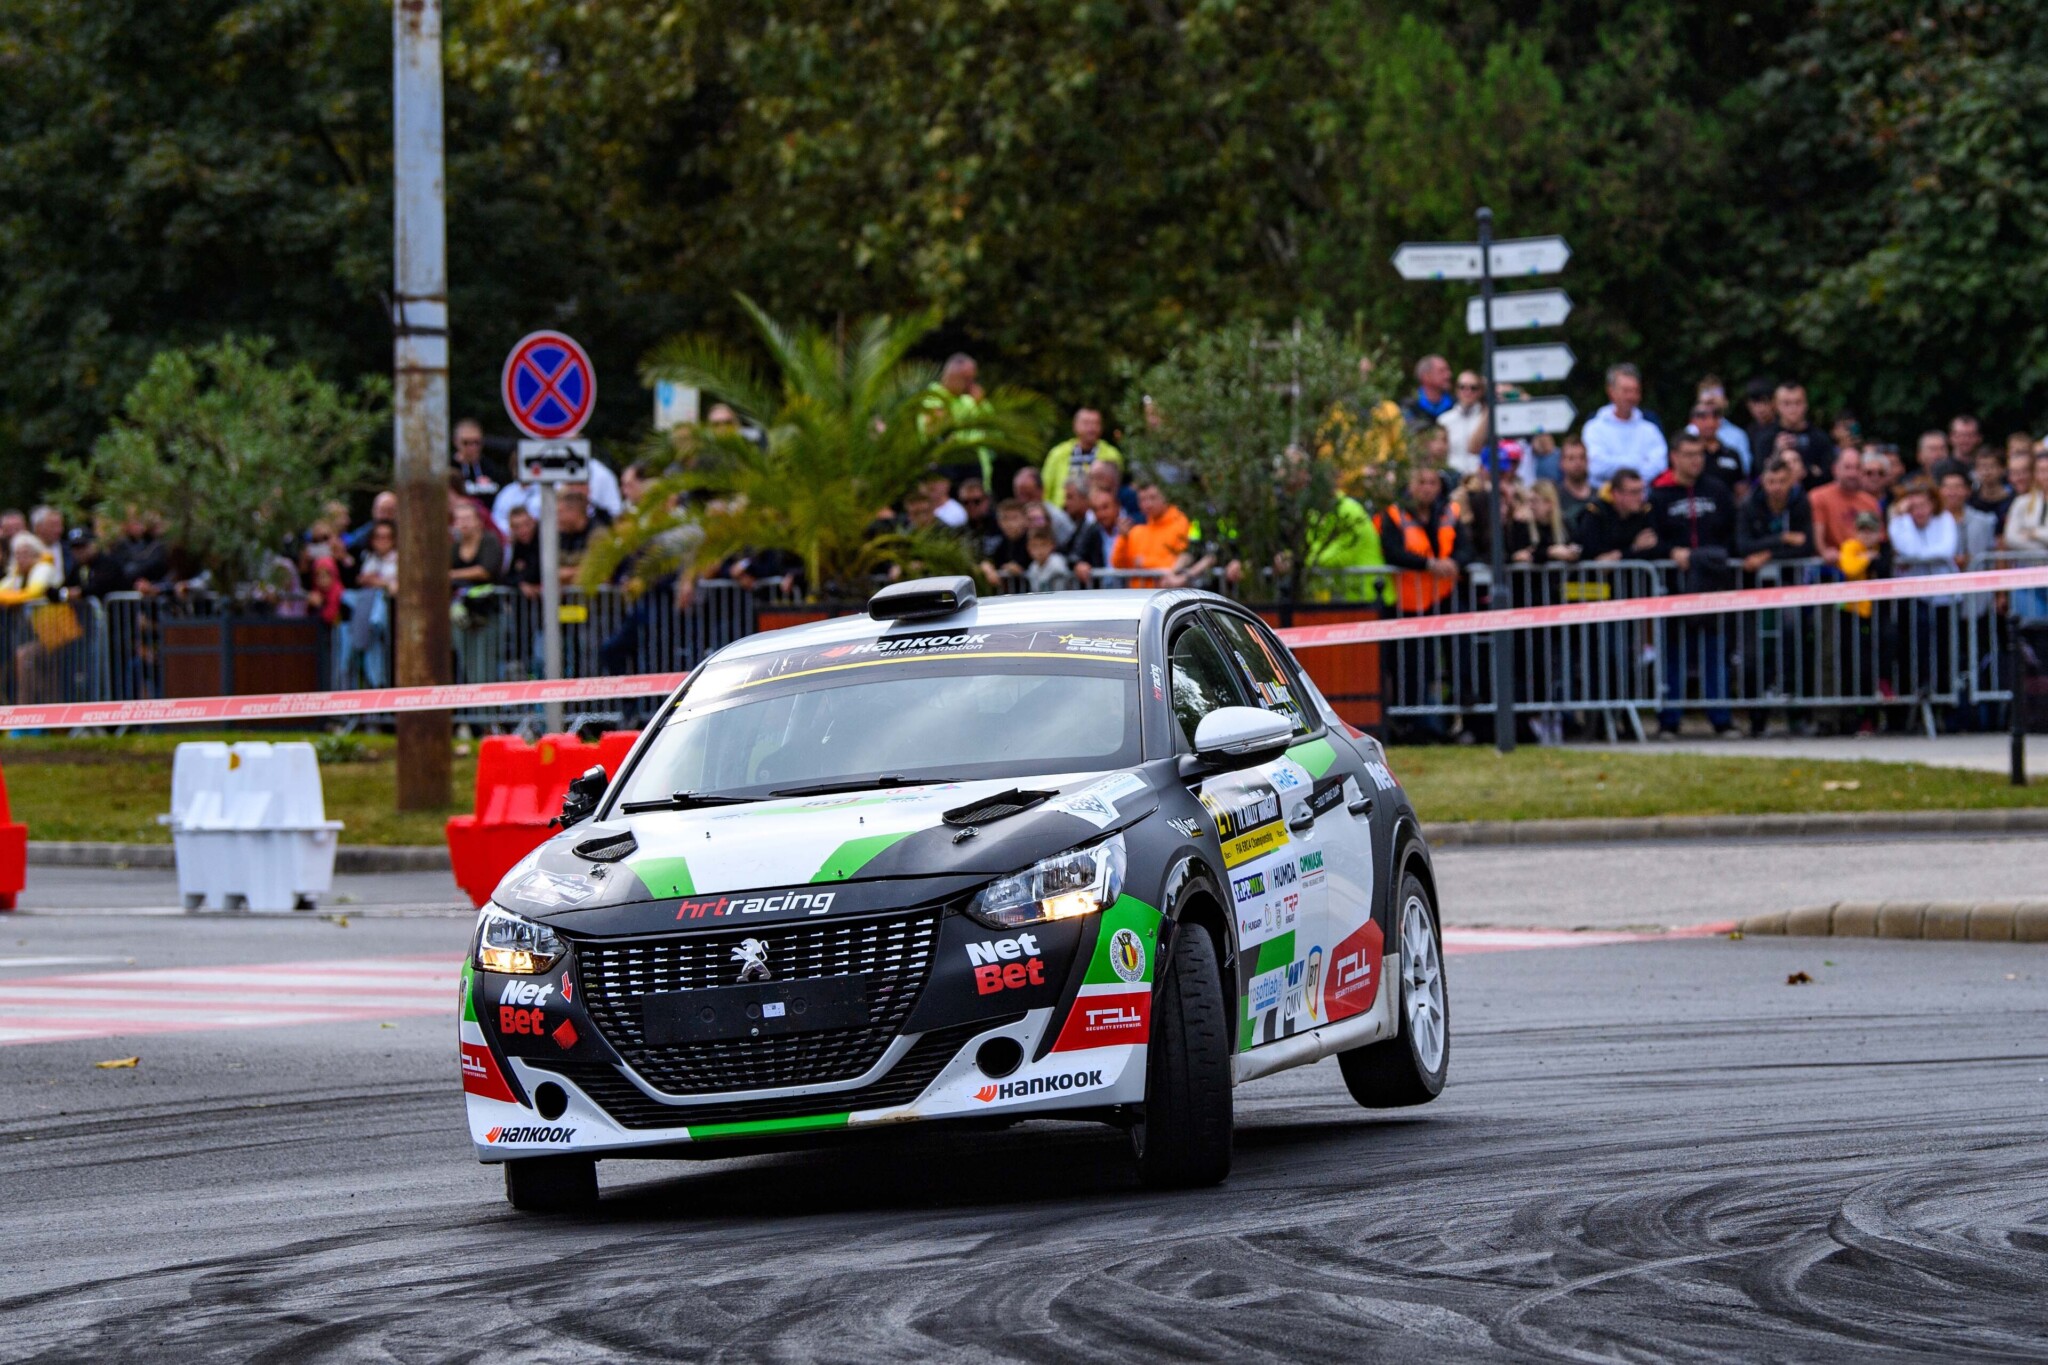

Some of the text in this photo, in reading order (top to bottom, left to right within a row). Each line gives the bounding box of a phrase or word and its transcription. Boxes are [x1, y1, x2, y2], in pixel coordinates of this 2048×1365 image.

[880, 643, 983, 658] driving emotion
[1251, 830, 1274, 852] Championship
[1274, 862, 1297, 889] HUMDA
[676, 892, 837, 921] hrtracing
[965, 932, 1041, 967] Net
[974, 957, 1045, 996] Bet
[500, 980, 555, 1007] Net
[1285, 990, 1302, 1018] OMV
[499, 1006, 545, 1036] Bet
[1085, 1006, 1142, 1025] TELL
[998, 1069, 1103, 1100] HANKOOK
[498, 1126, 577, 1144] HANKOOK
